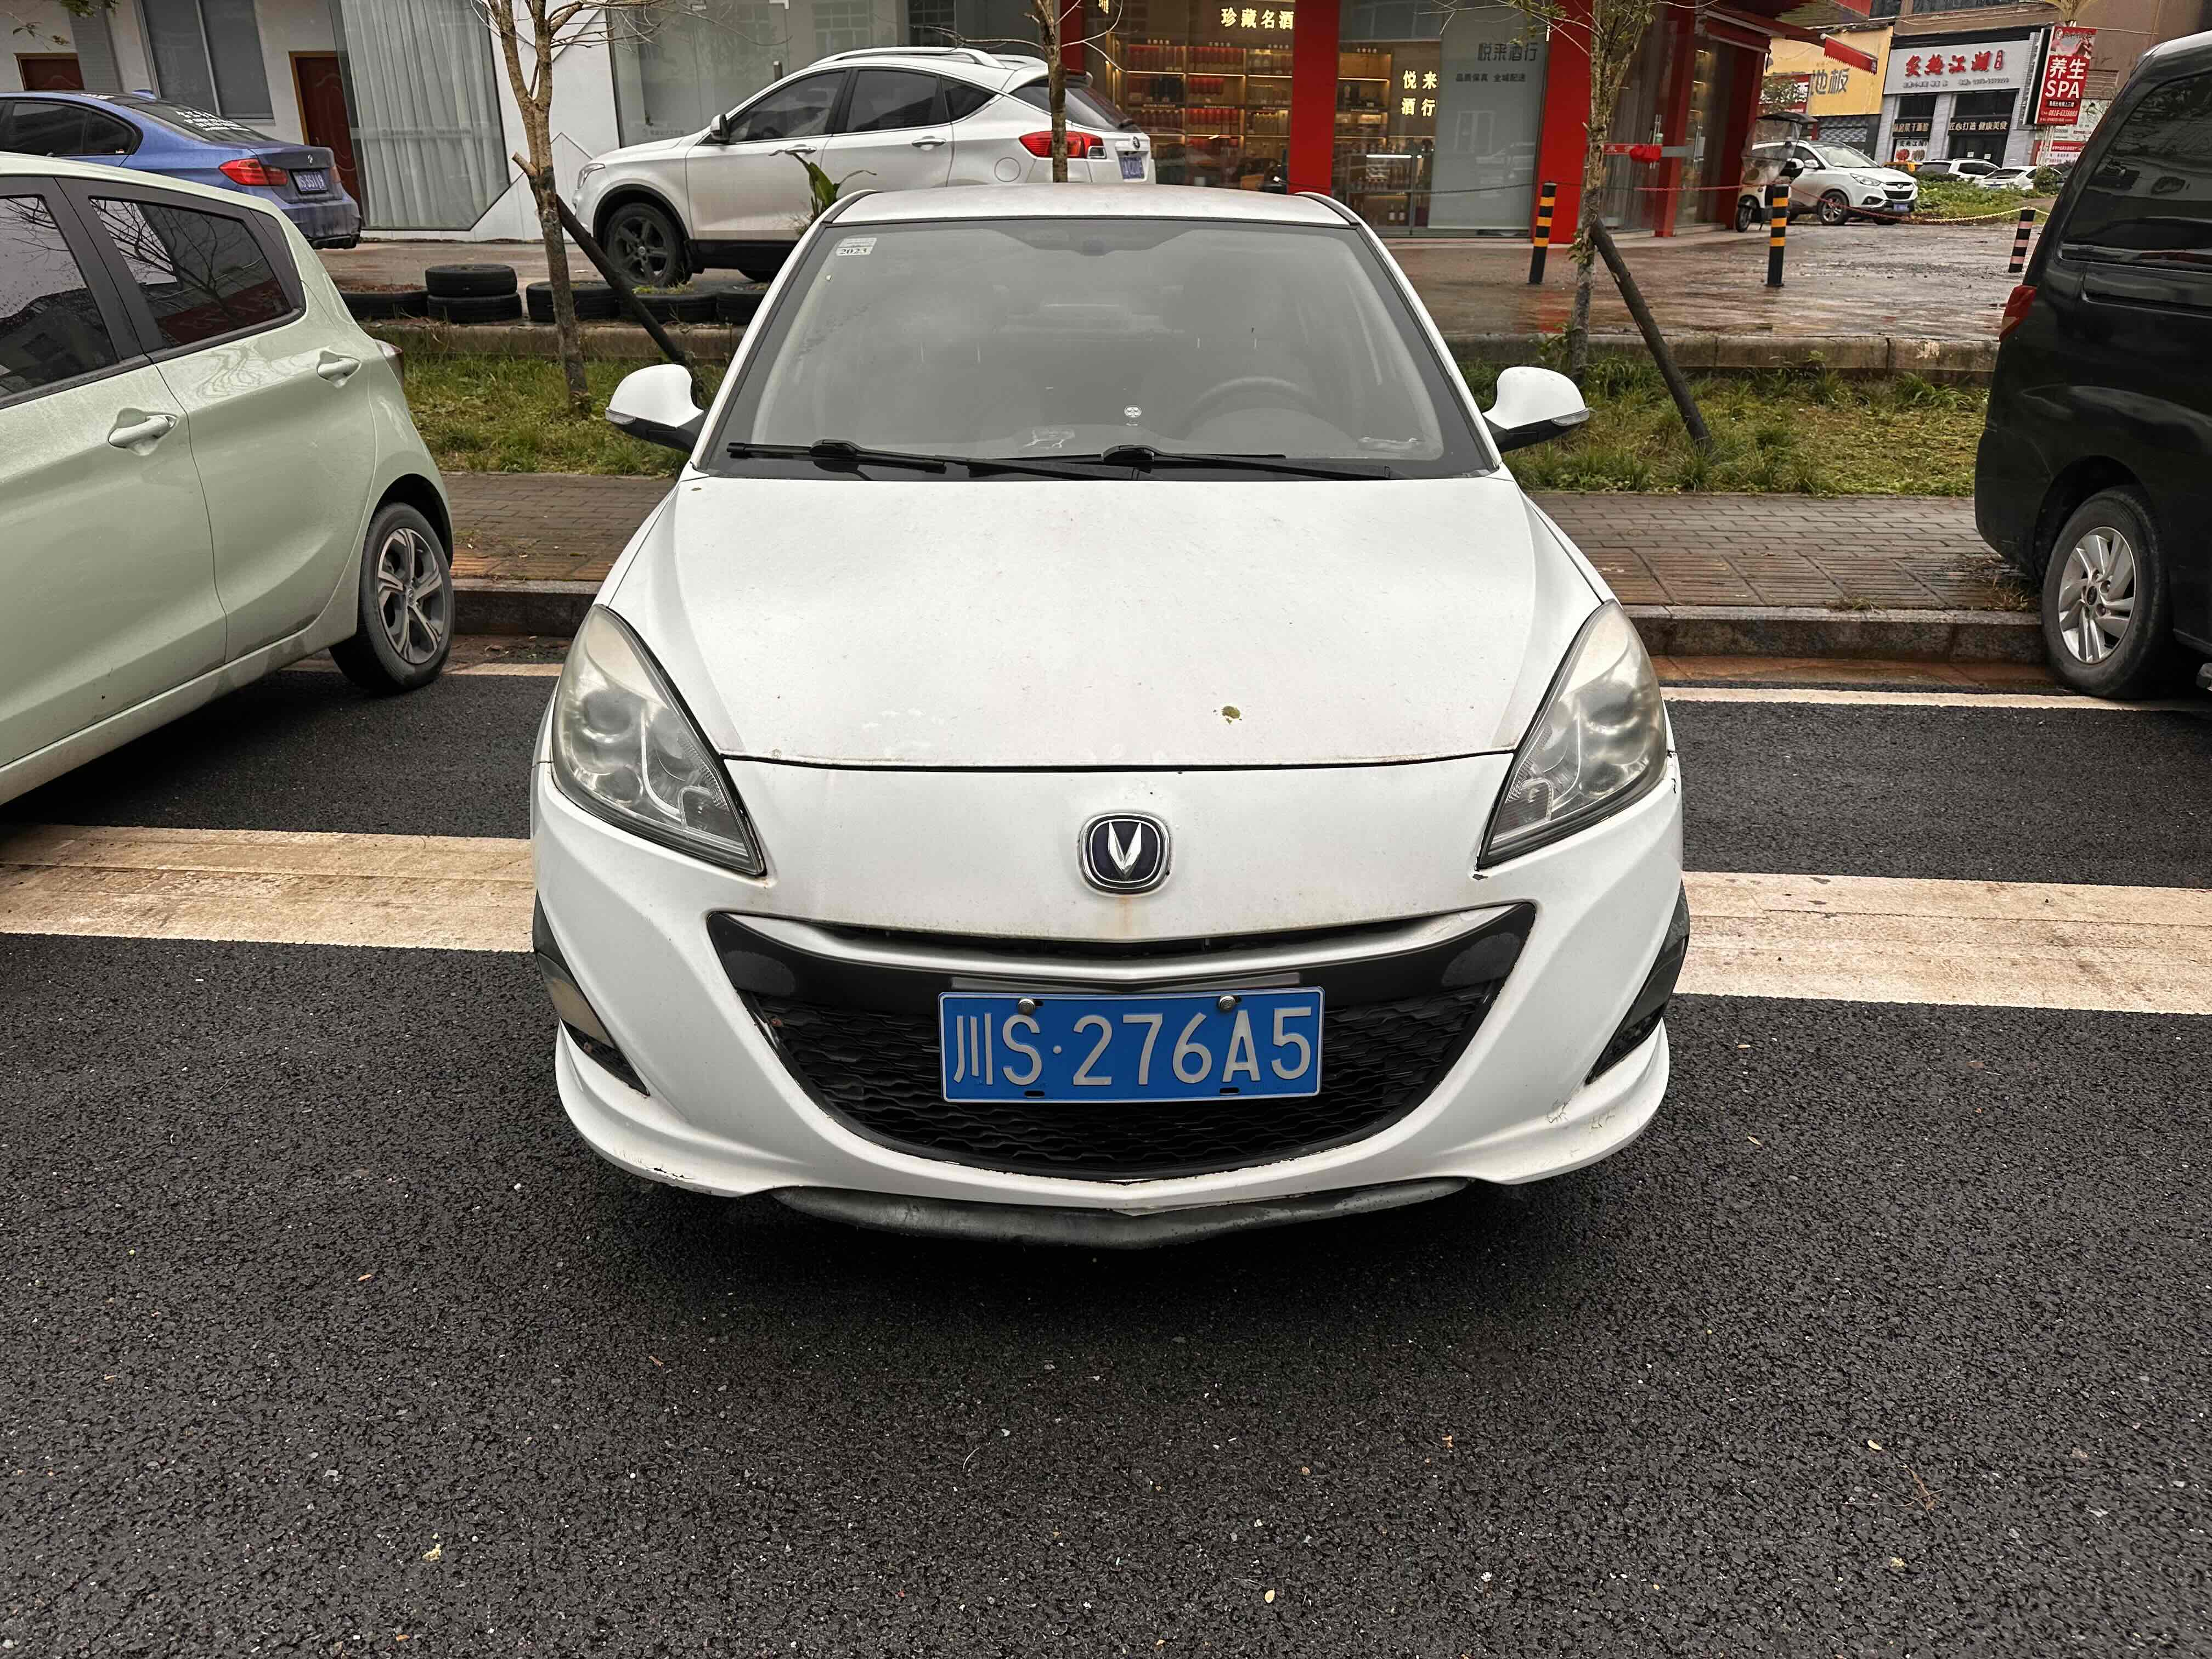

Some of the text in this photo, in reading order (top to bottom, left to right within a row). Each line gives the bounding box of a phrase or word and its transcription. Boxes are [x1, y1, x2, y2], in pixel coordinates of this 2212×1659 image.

[1221, 7, 1295, 30] 珍藏名酒
[1477, 42, 1538, 61] 悦来酒行
[2049, 57, 2086, 80] 养生
[1403, 70, 1437, 89] 悦来
[2045, 80, 2080, 99] SPA
[1401, 97, 1436, 117] 酒行
[952, 1006, 1313, 1087] 川S·276A5
